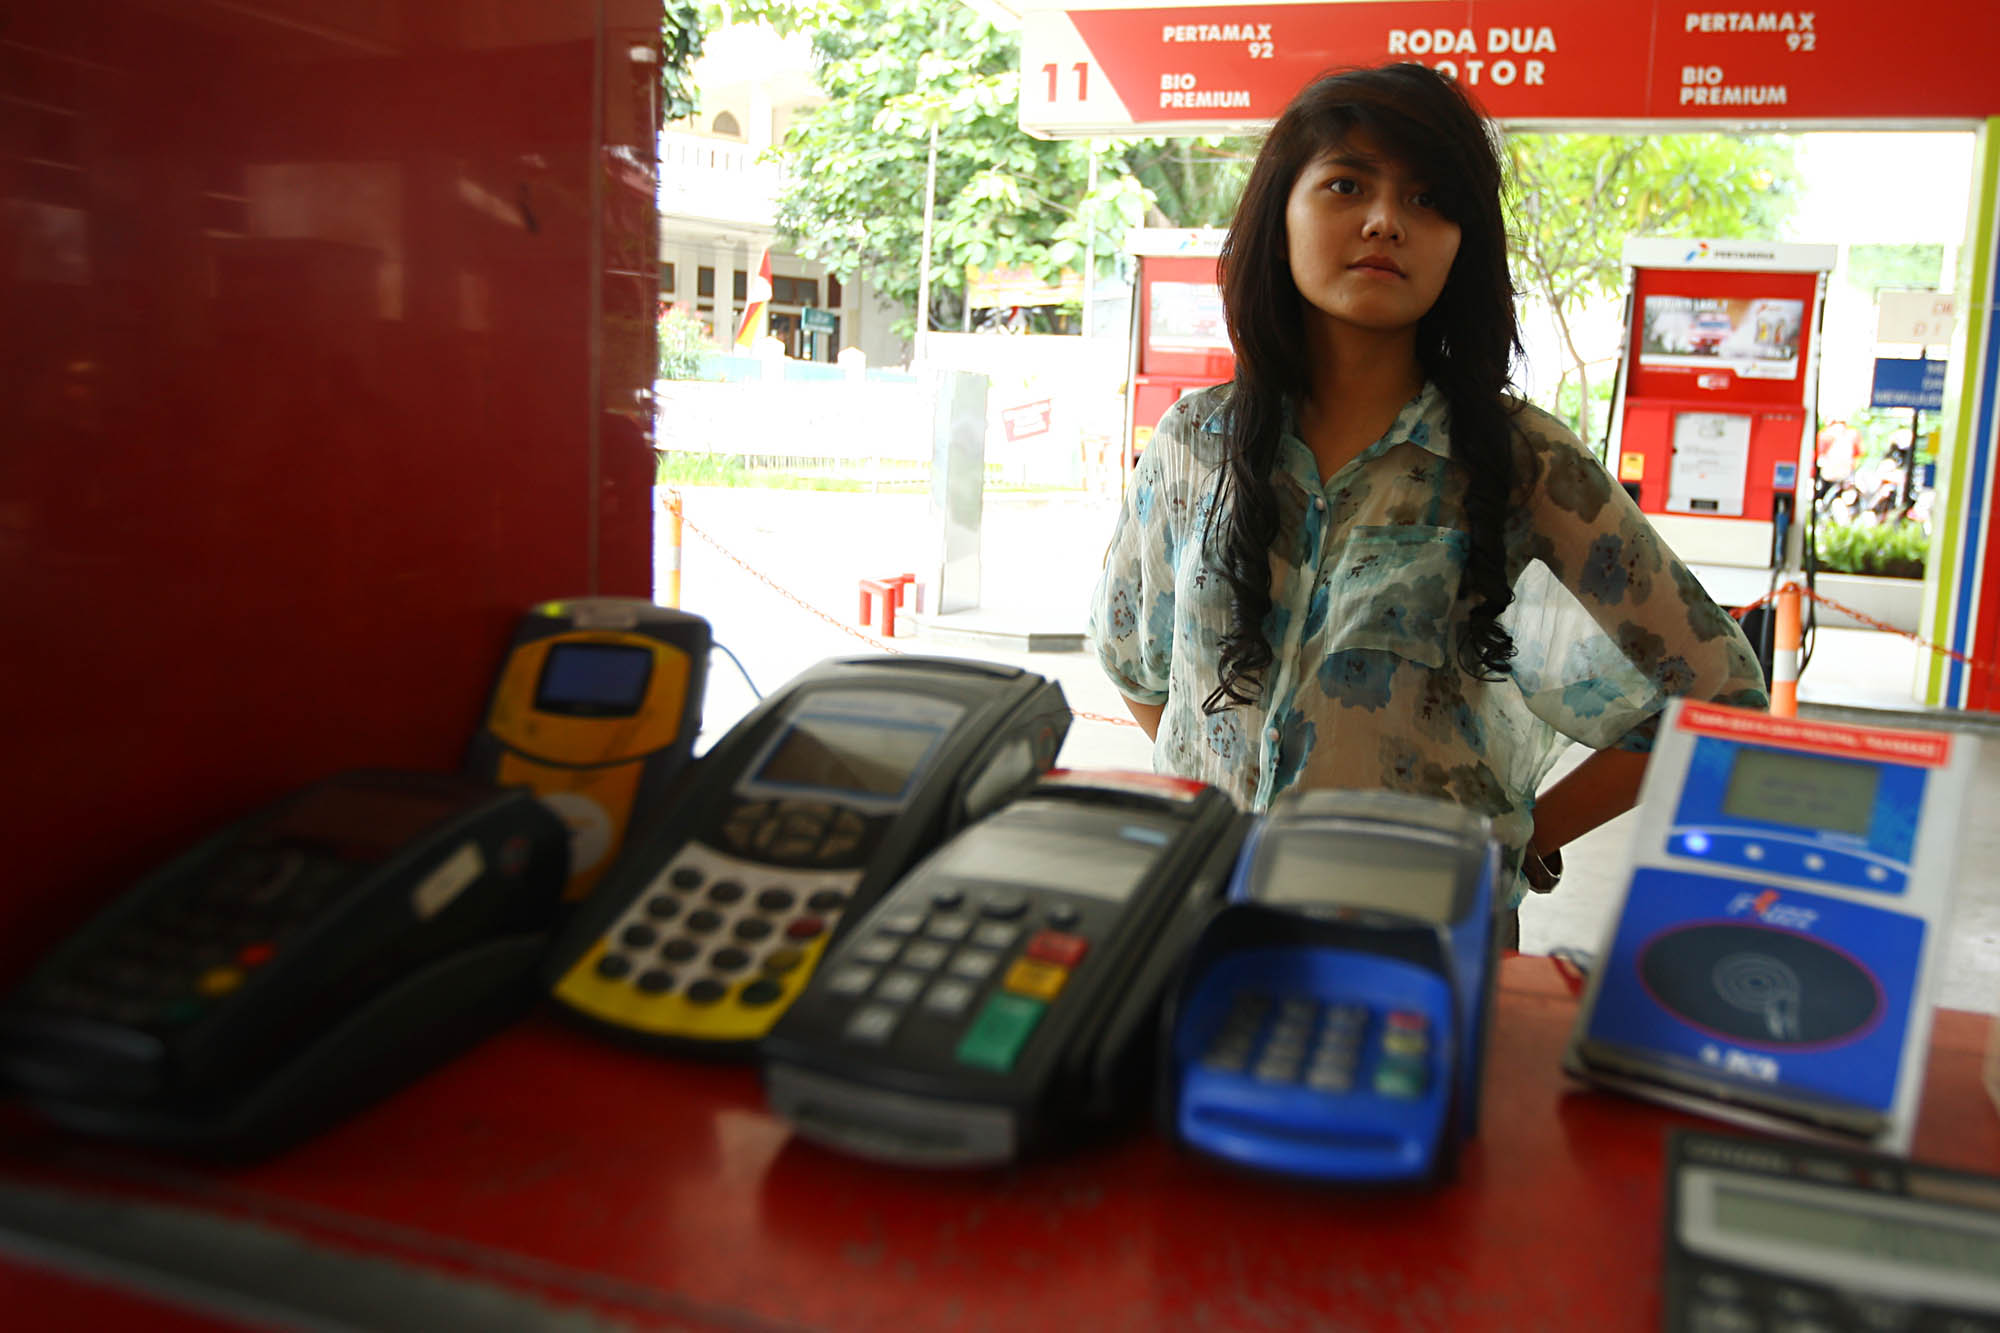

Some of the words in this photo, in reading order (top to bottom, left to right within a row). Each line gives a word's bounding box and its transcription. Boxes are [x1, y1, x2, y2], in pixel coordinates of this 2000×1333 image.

[1685, 12, 1815, 32] PERTAMAX
[1163, 24, 1272, 42] PERTAMAX
[1388, 29, 1477, 55] RODA
[1487, 27, 1557, 53] DUA
[1786, 32, 1816, 51] 92
[1247, 41, 1274, 59] 92
[1041, 63, 1088, 102] 11
[1161, 73, 1196, 90] BIO
[1400, 60, 1545, 86] OTOR
[1682, 66, 1723, 85] BIO
[1160, 91, 1250, 108] PREMIUM
[1680, 86, 1787, 105] PREMIUM
